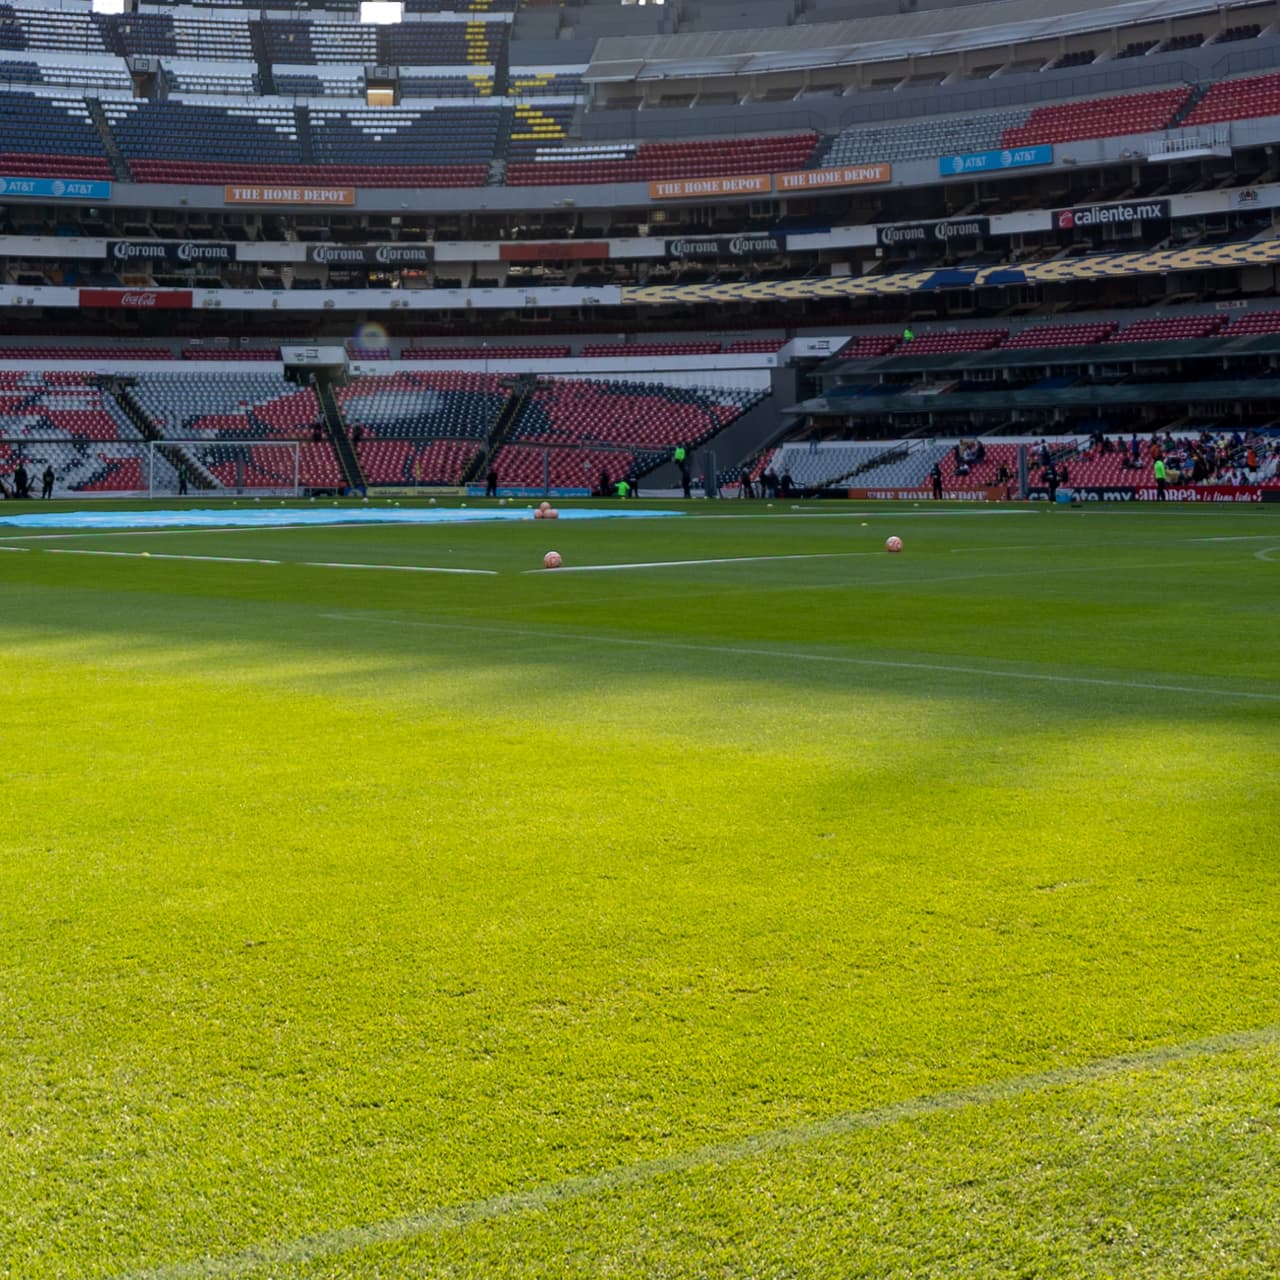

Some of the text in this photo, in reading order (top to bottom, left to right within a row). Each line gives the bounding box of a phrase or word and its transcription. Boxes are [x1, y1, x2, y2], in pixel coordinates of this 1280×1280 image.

[965, 151, 1037, 167] AT&T AT&T
[656, 178, 762, 195] THE HOME DEPOT
[782, 168, 883, 188] THE HOME DEPOT
[9, 181, 93, 195] AT&T AT&T
[232, 188, 347, 202] THE HOME DEPOT
[1074, 203, 1161, 225] caliente.mx
[881, 222, 980, 244] Corona Corona
[113, 241, 228, 259] Corona Corona
[312, 246, 427, 263] Corona Corona
[670, 236, 778, 256] Corona Corona
[121, 292, 157, 305] Coca-Cola
